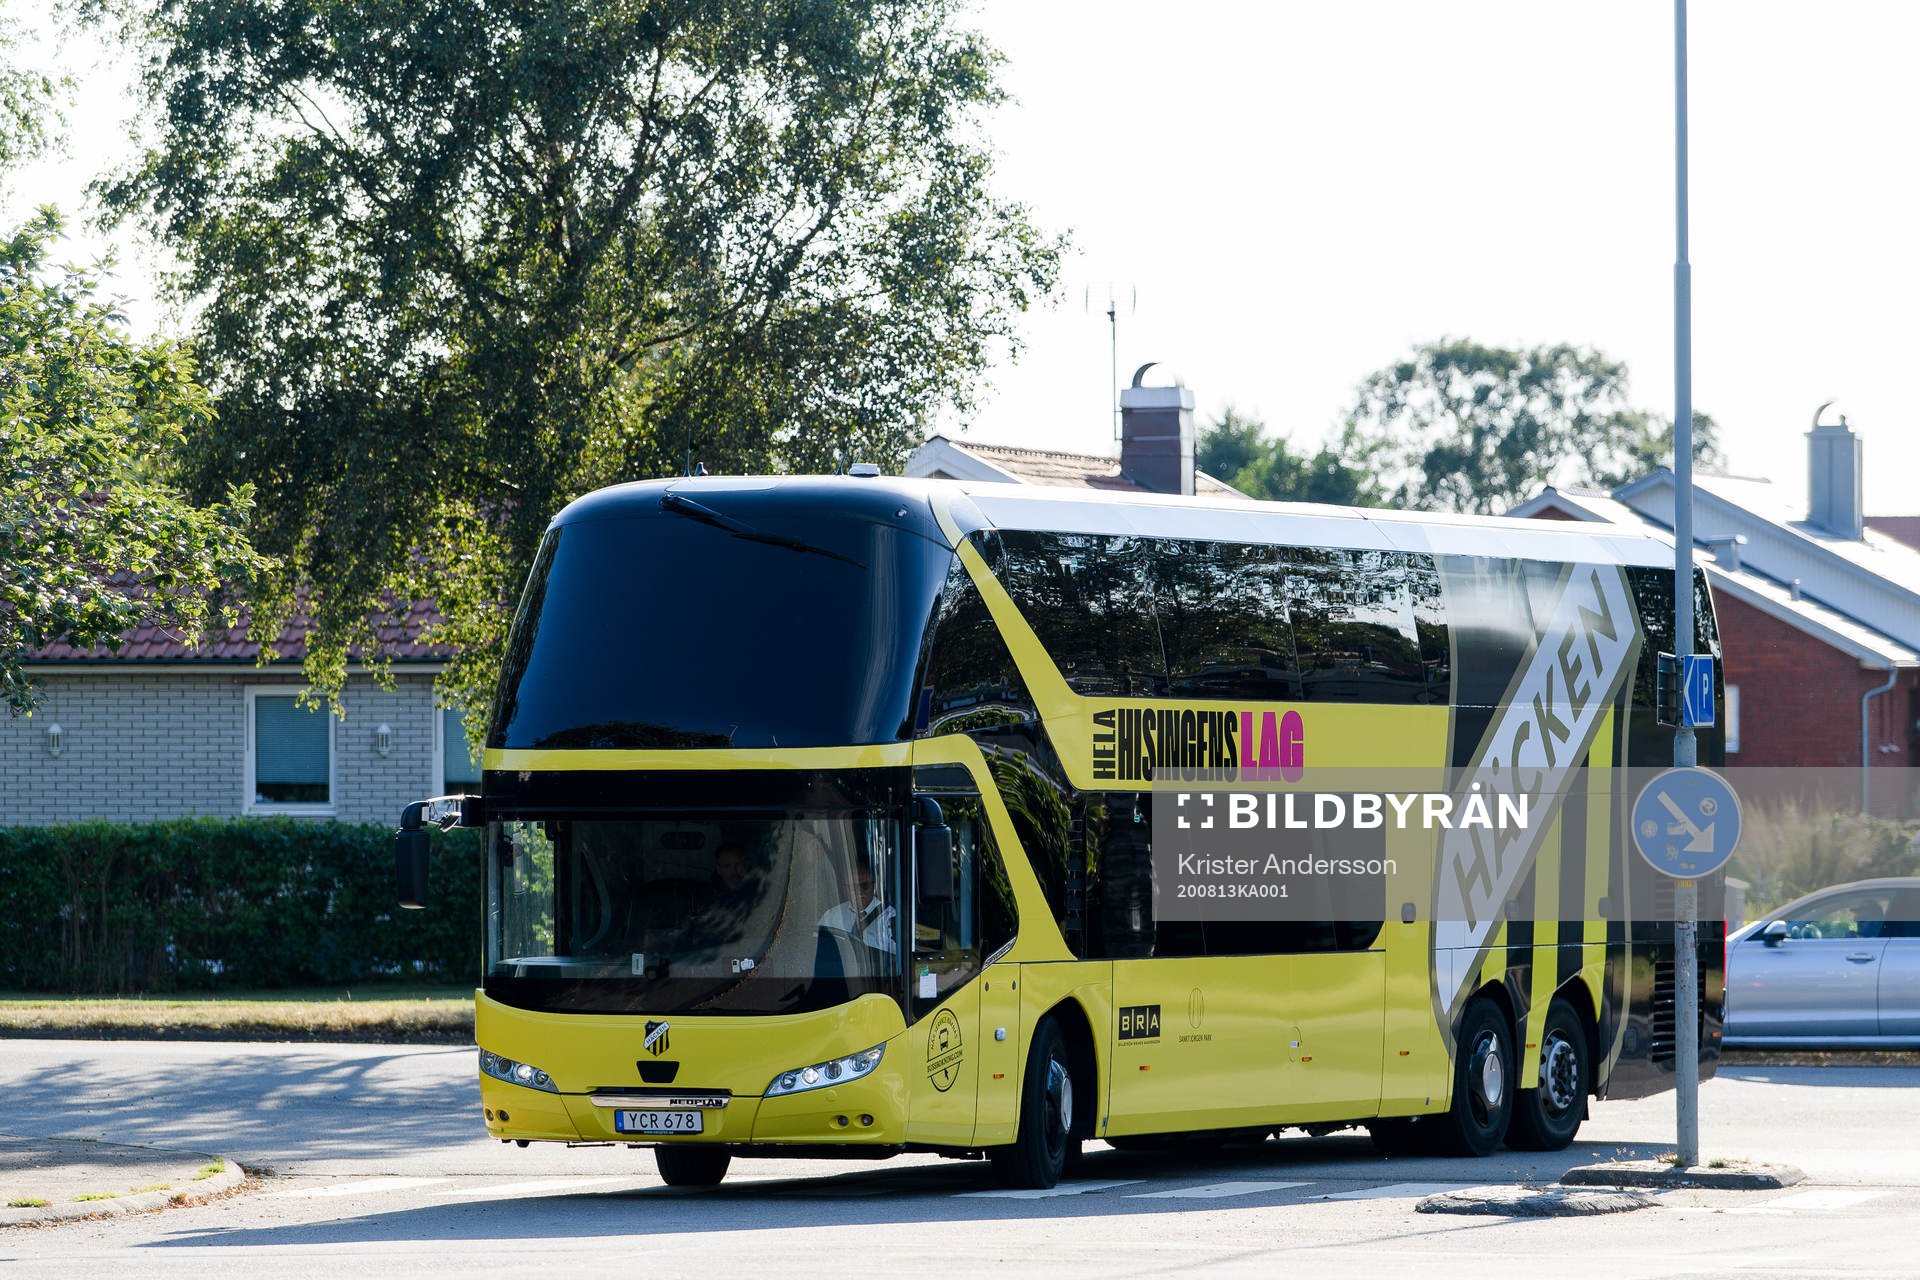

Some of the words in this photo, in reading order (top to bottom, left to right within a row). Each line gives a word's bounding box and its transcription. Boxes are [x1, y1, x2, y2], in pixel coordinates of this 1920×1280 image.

[1702, 673, 1709, 710] P
[1093, 709, 1116, 779] HELA
[1118, 708, 1238, 783] HISINGENS
[1240, 710, 1304, 783] LAG
[1453, 569, 1618, 934] HÄCKEN
[629, 1113, 659, 1129] YCR
[664, 1113, 695, 1129] 678
[669, 1098, 723, 1107] NEOPLAN
